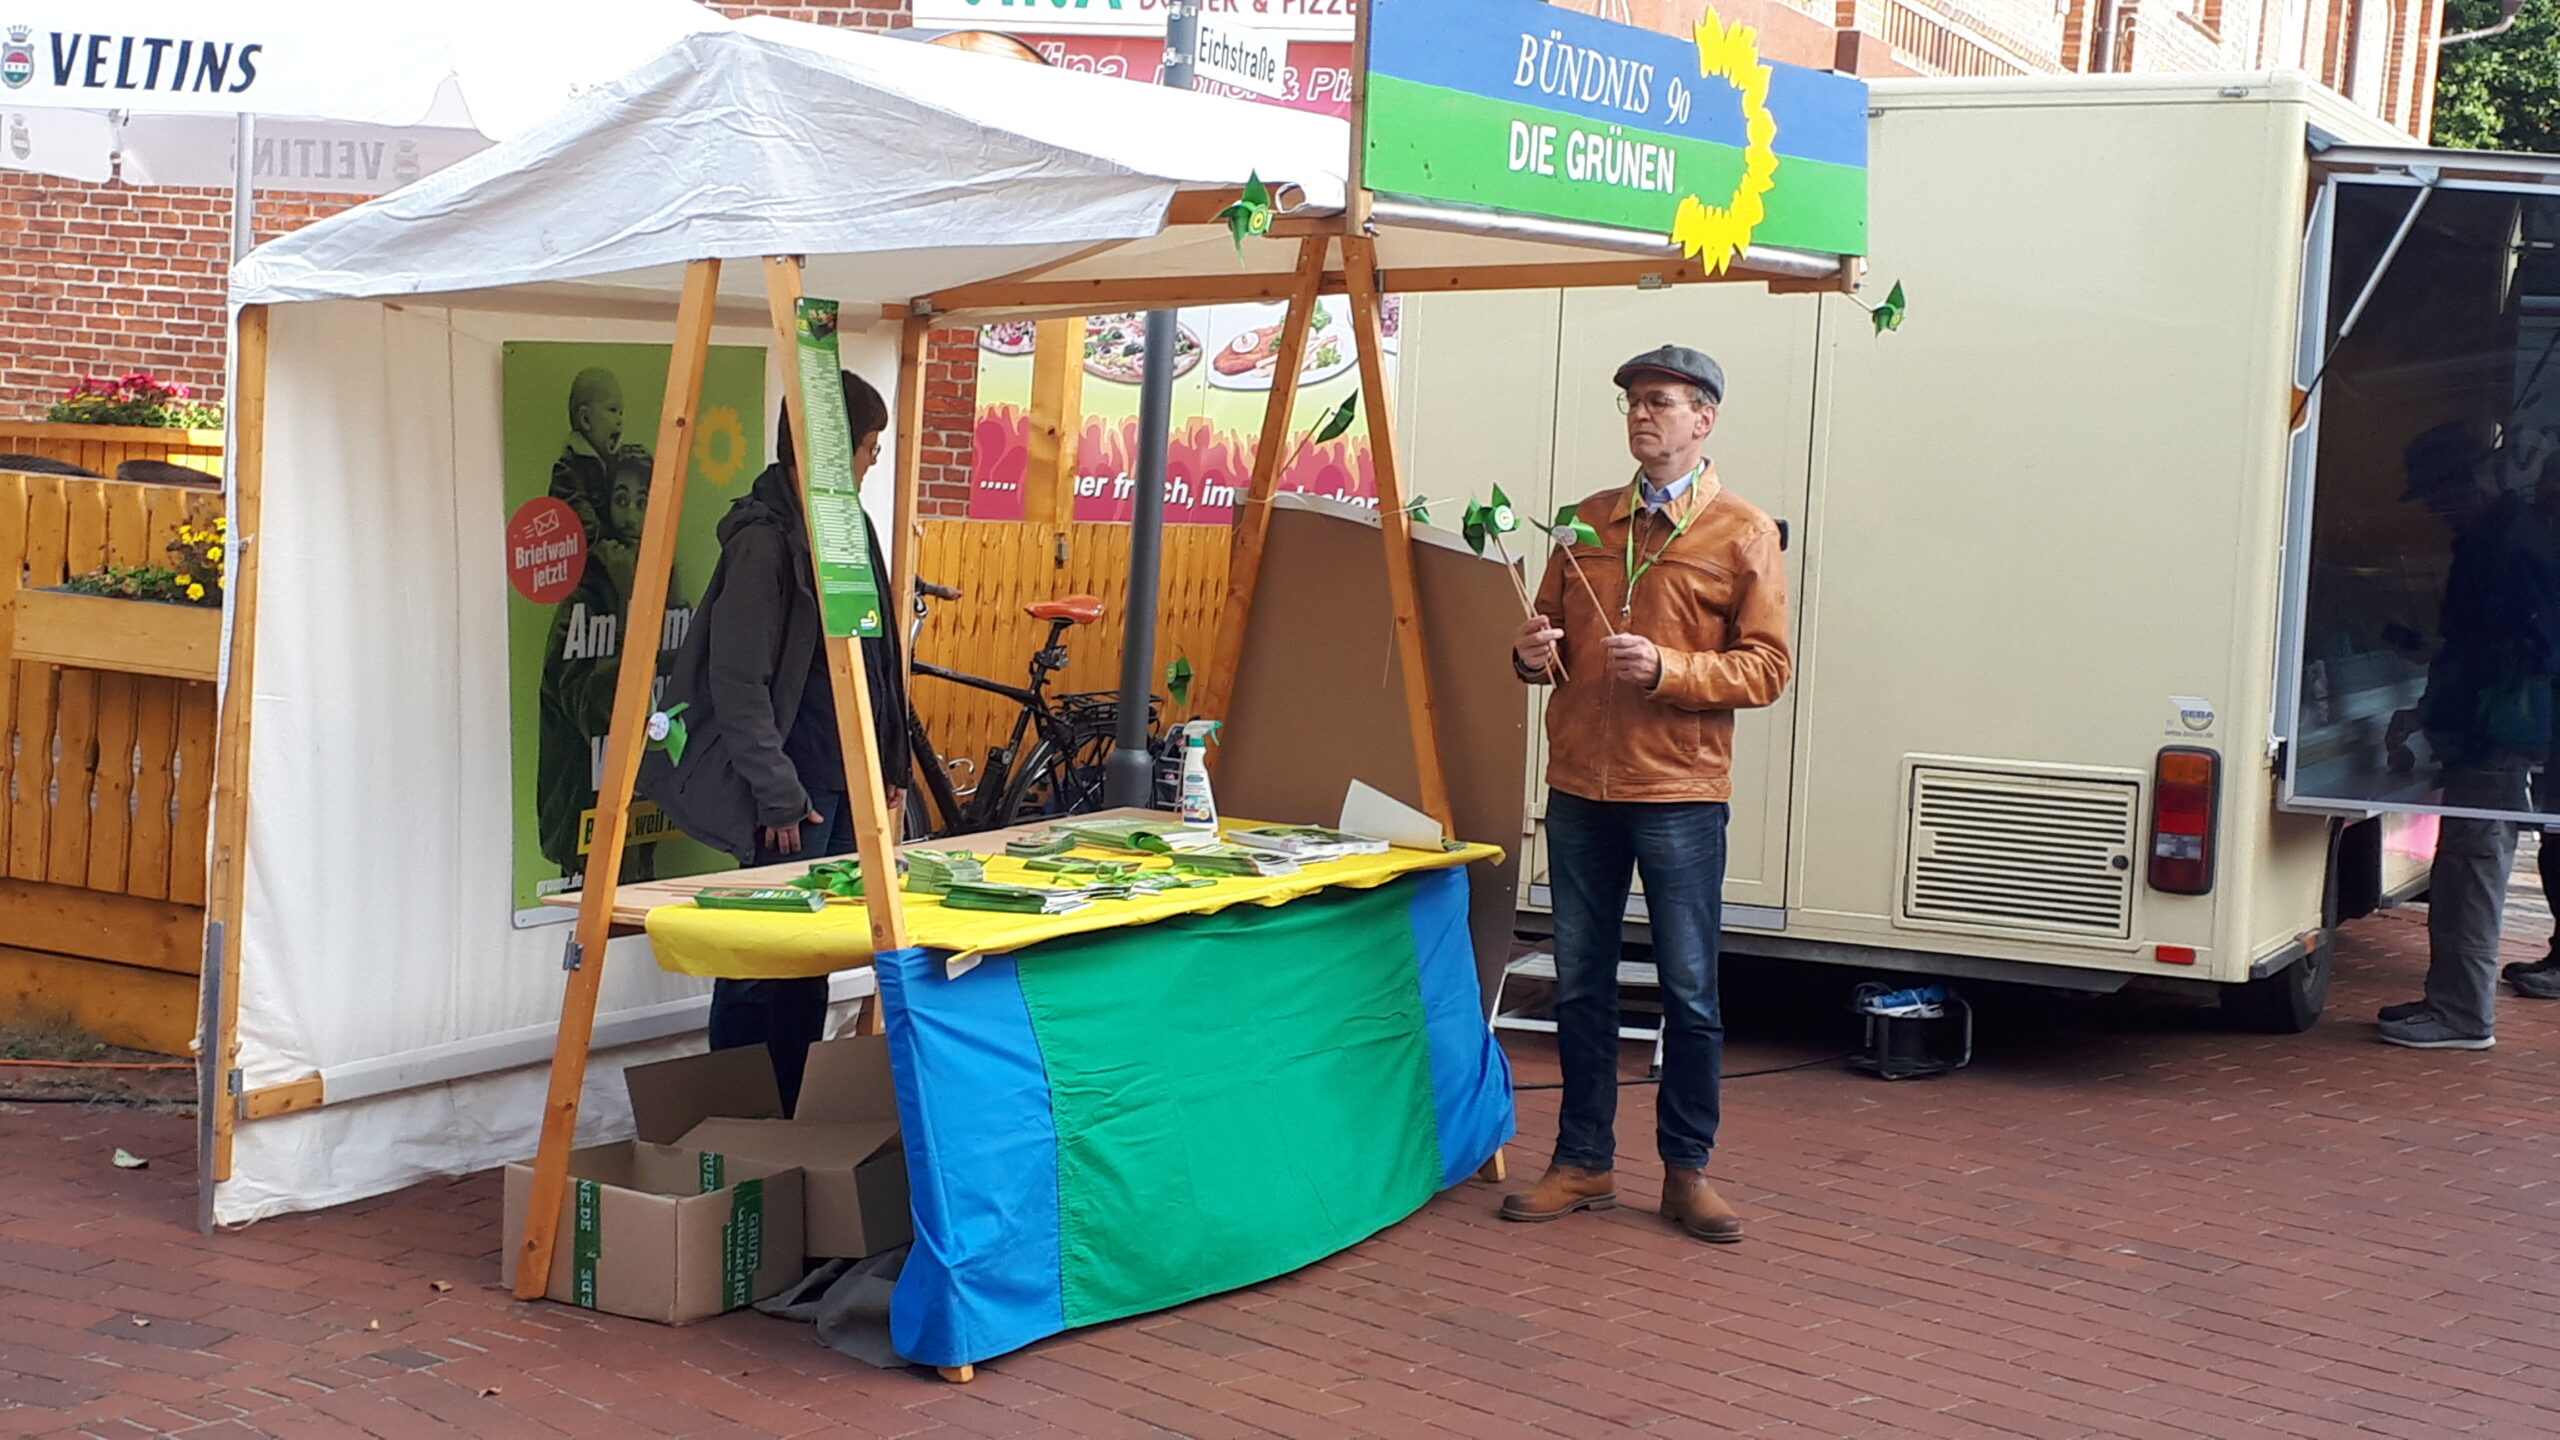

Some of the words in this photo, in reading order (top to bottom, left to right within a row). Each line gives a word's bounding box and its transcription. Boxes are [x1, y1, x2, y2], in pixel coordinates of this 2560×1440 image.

[49, 32, 263, 93] VELTINS
[1198, 26, 1276, 84] Eichstraße
[1513, 29, 1654, 114] BÜNDNIS
[1664, 76, 1692, 125] 90
[1306, 68, 1353, 102] Pi
[1508, 120, 1557, 176] DIE
[1566, 125, 1676, 194] GRÜNEN
[515, 532, 578, 570] Briefwahl
[533, 559, 568, 593] jetzt!
